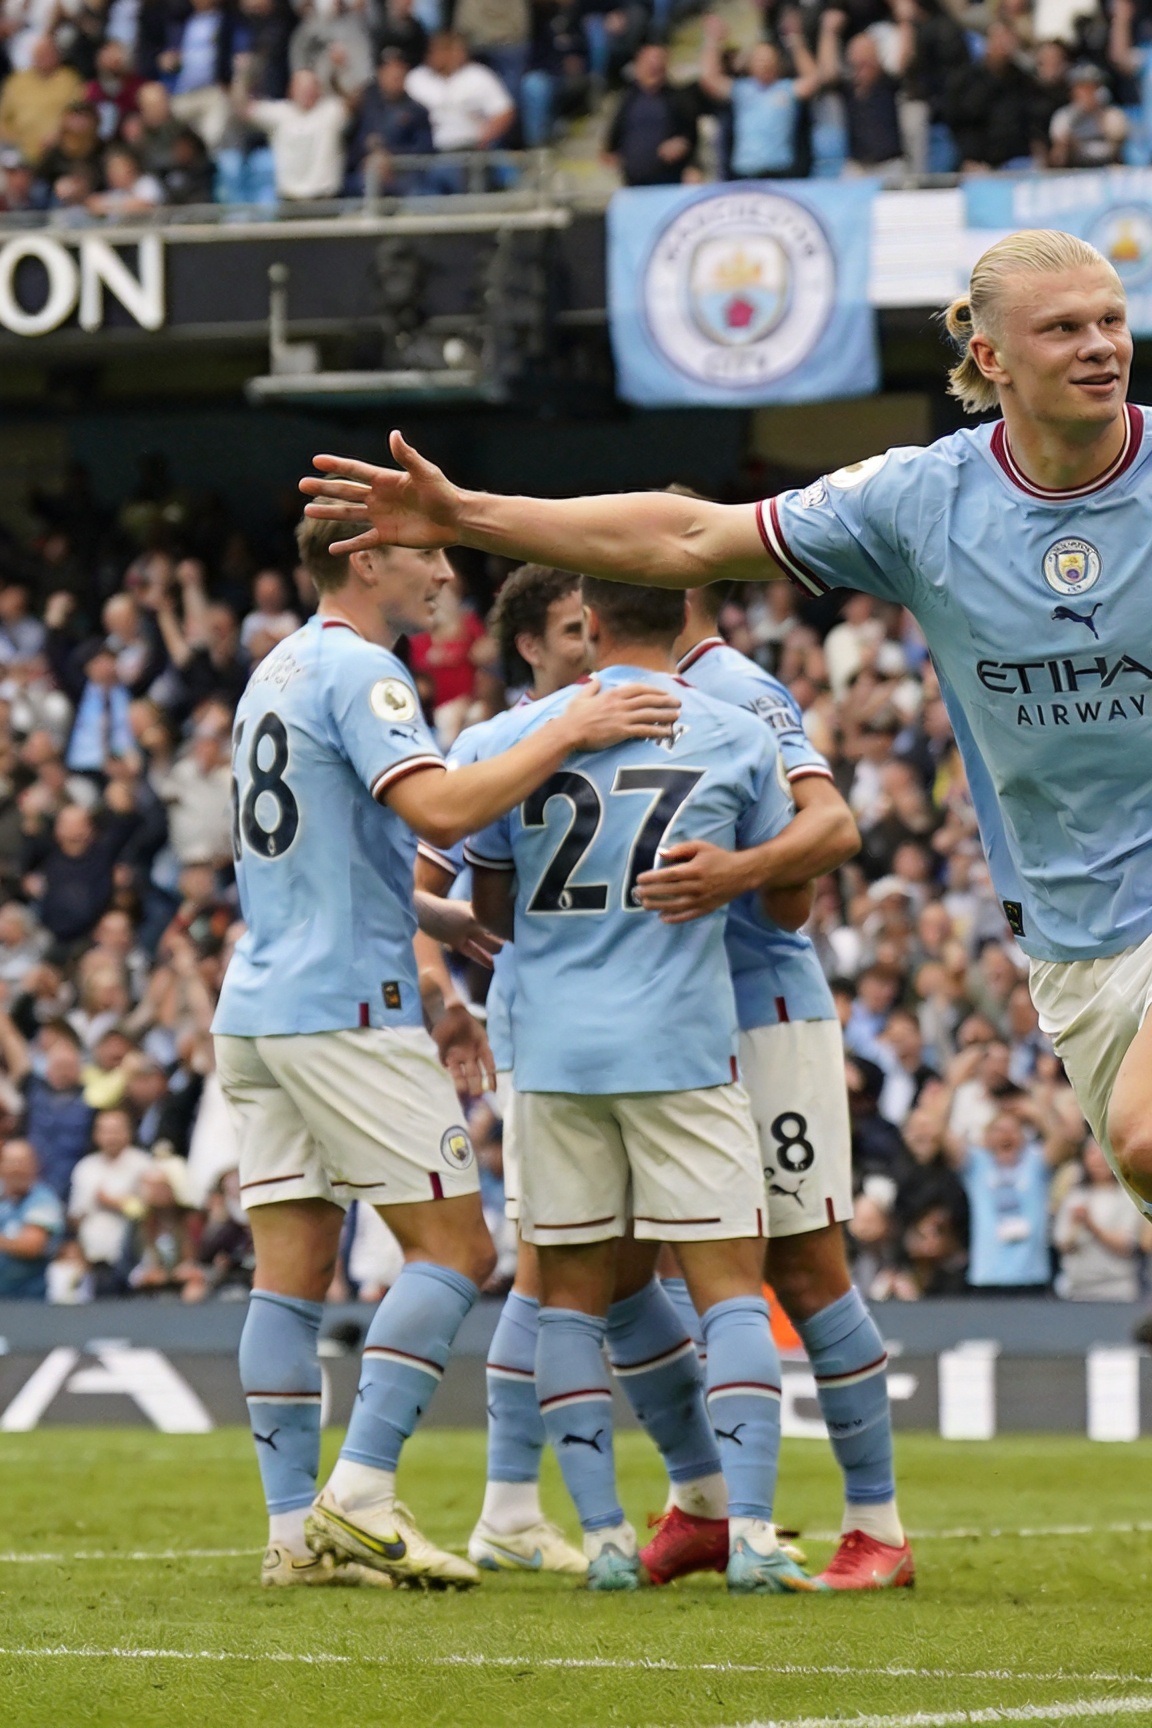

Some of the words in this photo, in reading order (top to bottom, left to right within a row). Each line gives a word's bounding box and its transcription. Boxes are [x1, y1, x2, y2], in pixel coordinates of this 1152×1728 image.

[0, 232, 167, 336] ON
[521, 764, 710, 915] 27
[770, 1111, 815, 1173] 8
